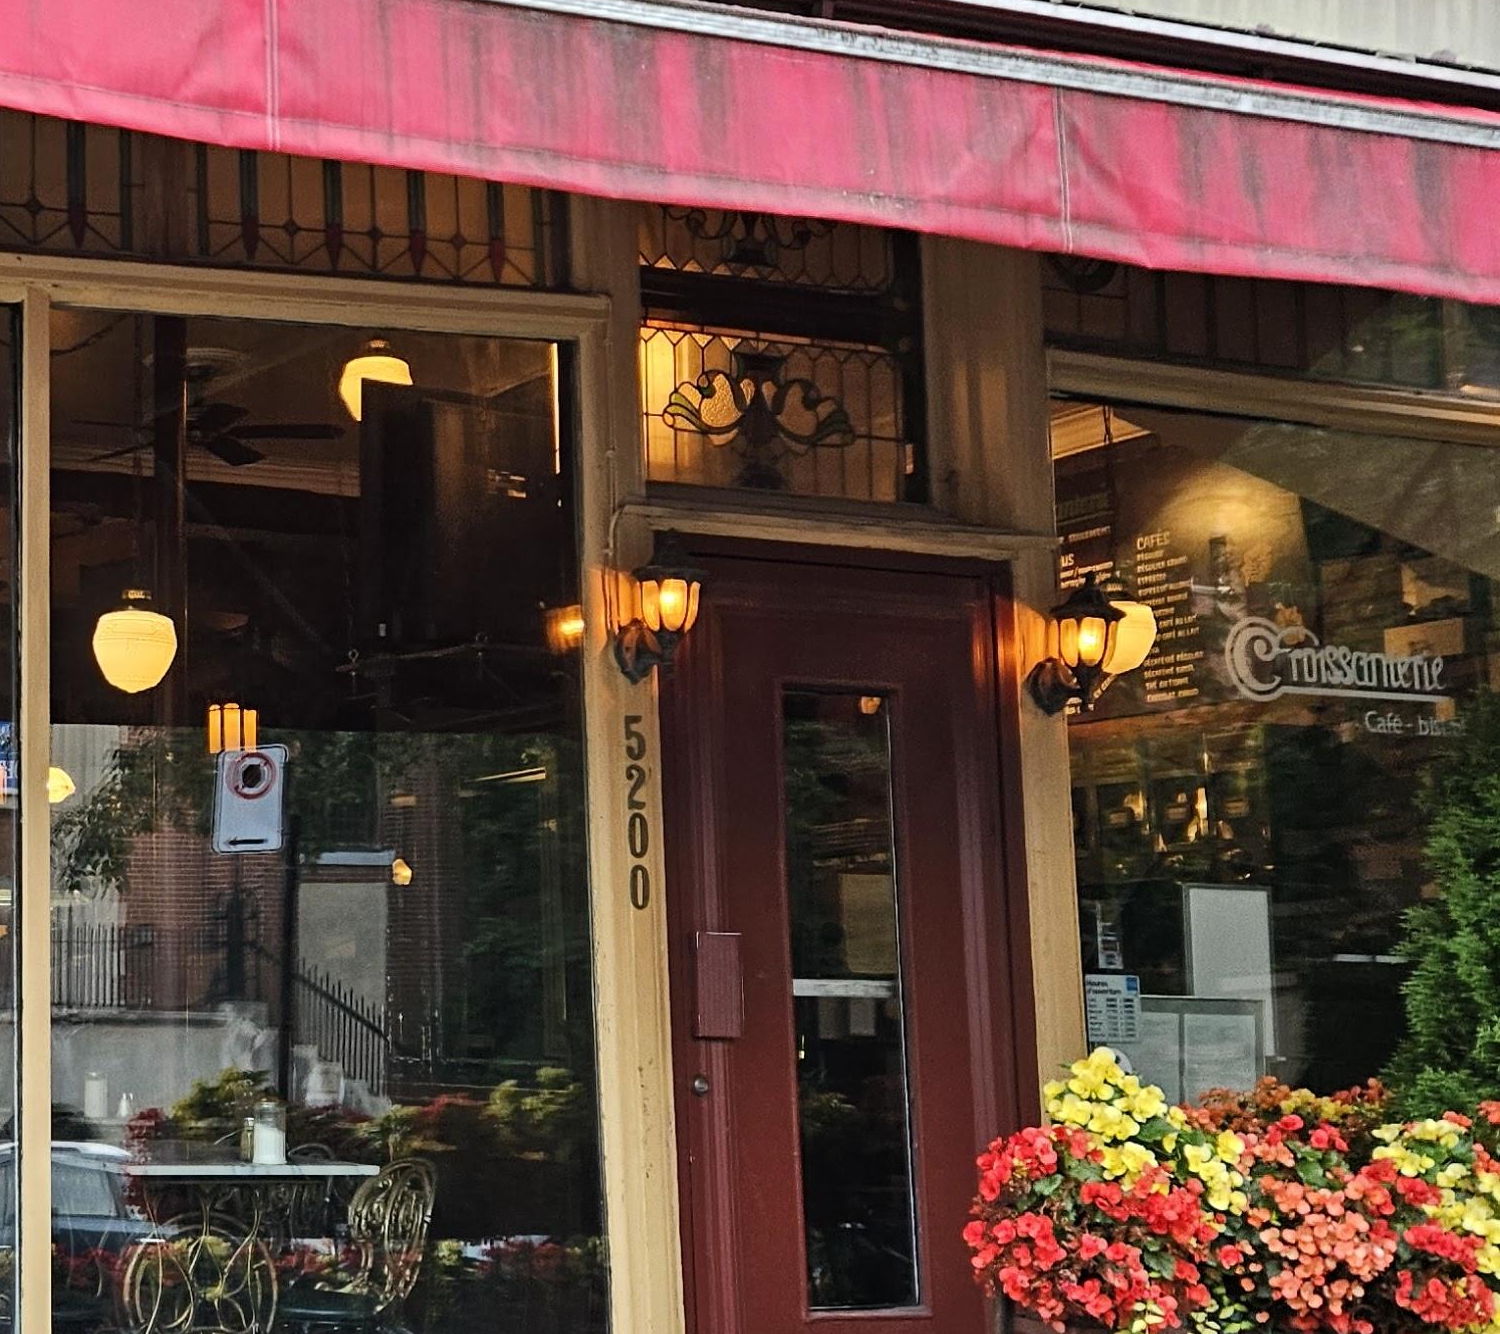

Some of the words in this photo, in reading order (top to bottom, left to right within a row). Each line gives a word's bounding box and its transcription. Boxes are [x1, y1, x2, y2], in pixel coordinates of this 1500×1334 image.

[1137, 528, 1170, 550] CAFÉS
[1225, 617, 1446, 701] Croissanterie
[1365, 710, 1402, 734] Café
[624, 714, 650, 910] 5200
